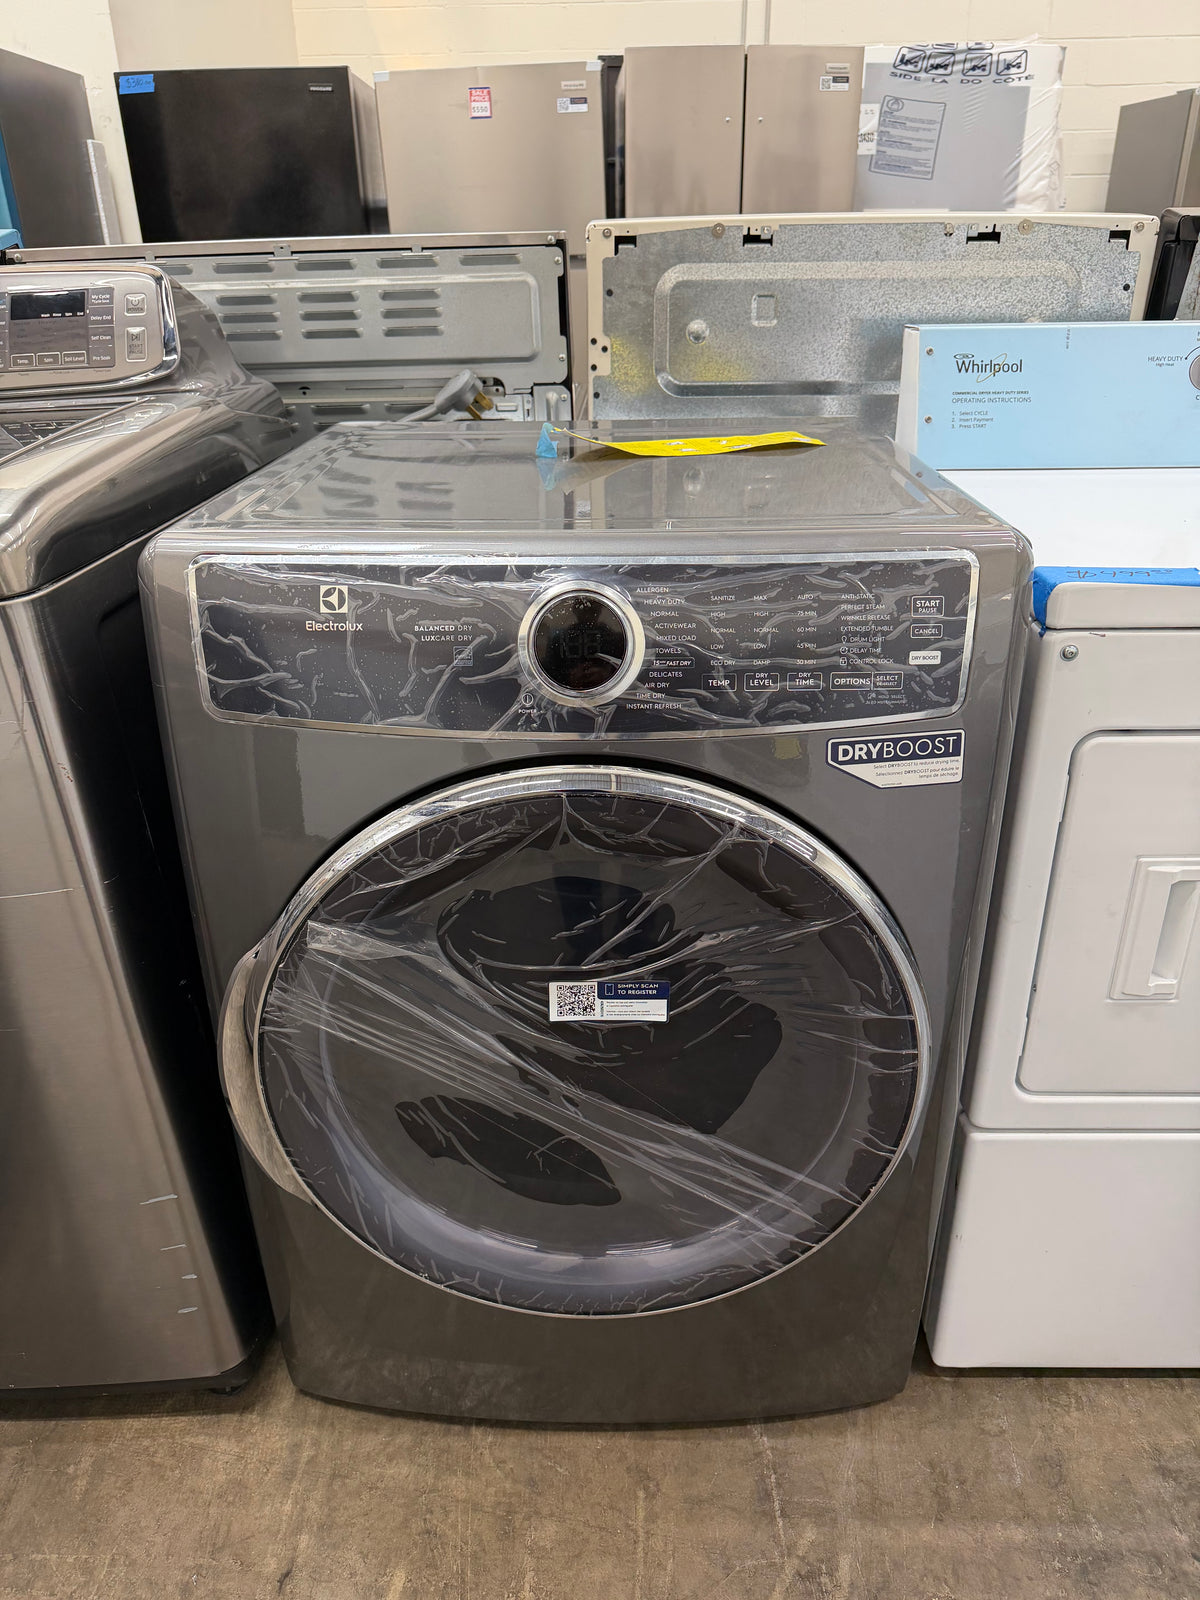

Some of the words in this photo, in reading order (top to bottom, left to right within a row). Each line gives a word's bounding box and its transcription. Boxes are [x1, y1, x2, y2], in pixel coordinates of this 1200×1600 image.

[889, 71, 921, 81] SIDE
[956, 359, 1023, 377] Whirlpool
[305, 620, 363, 631] Electrolux
[838, 736, 957, 761] DRYBOOST
